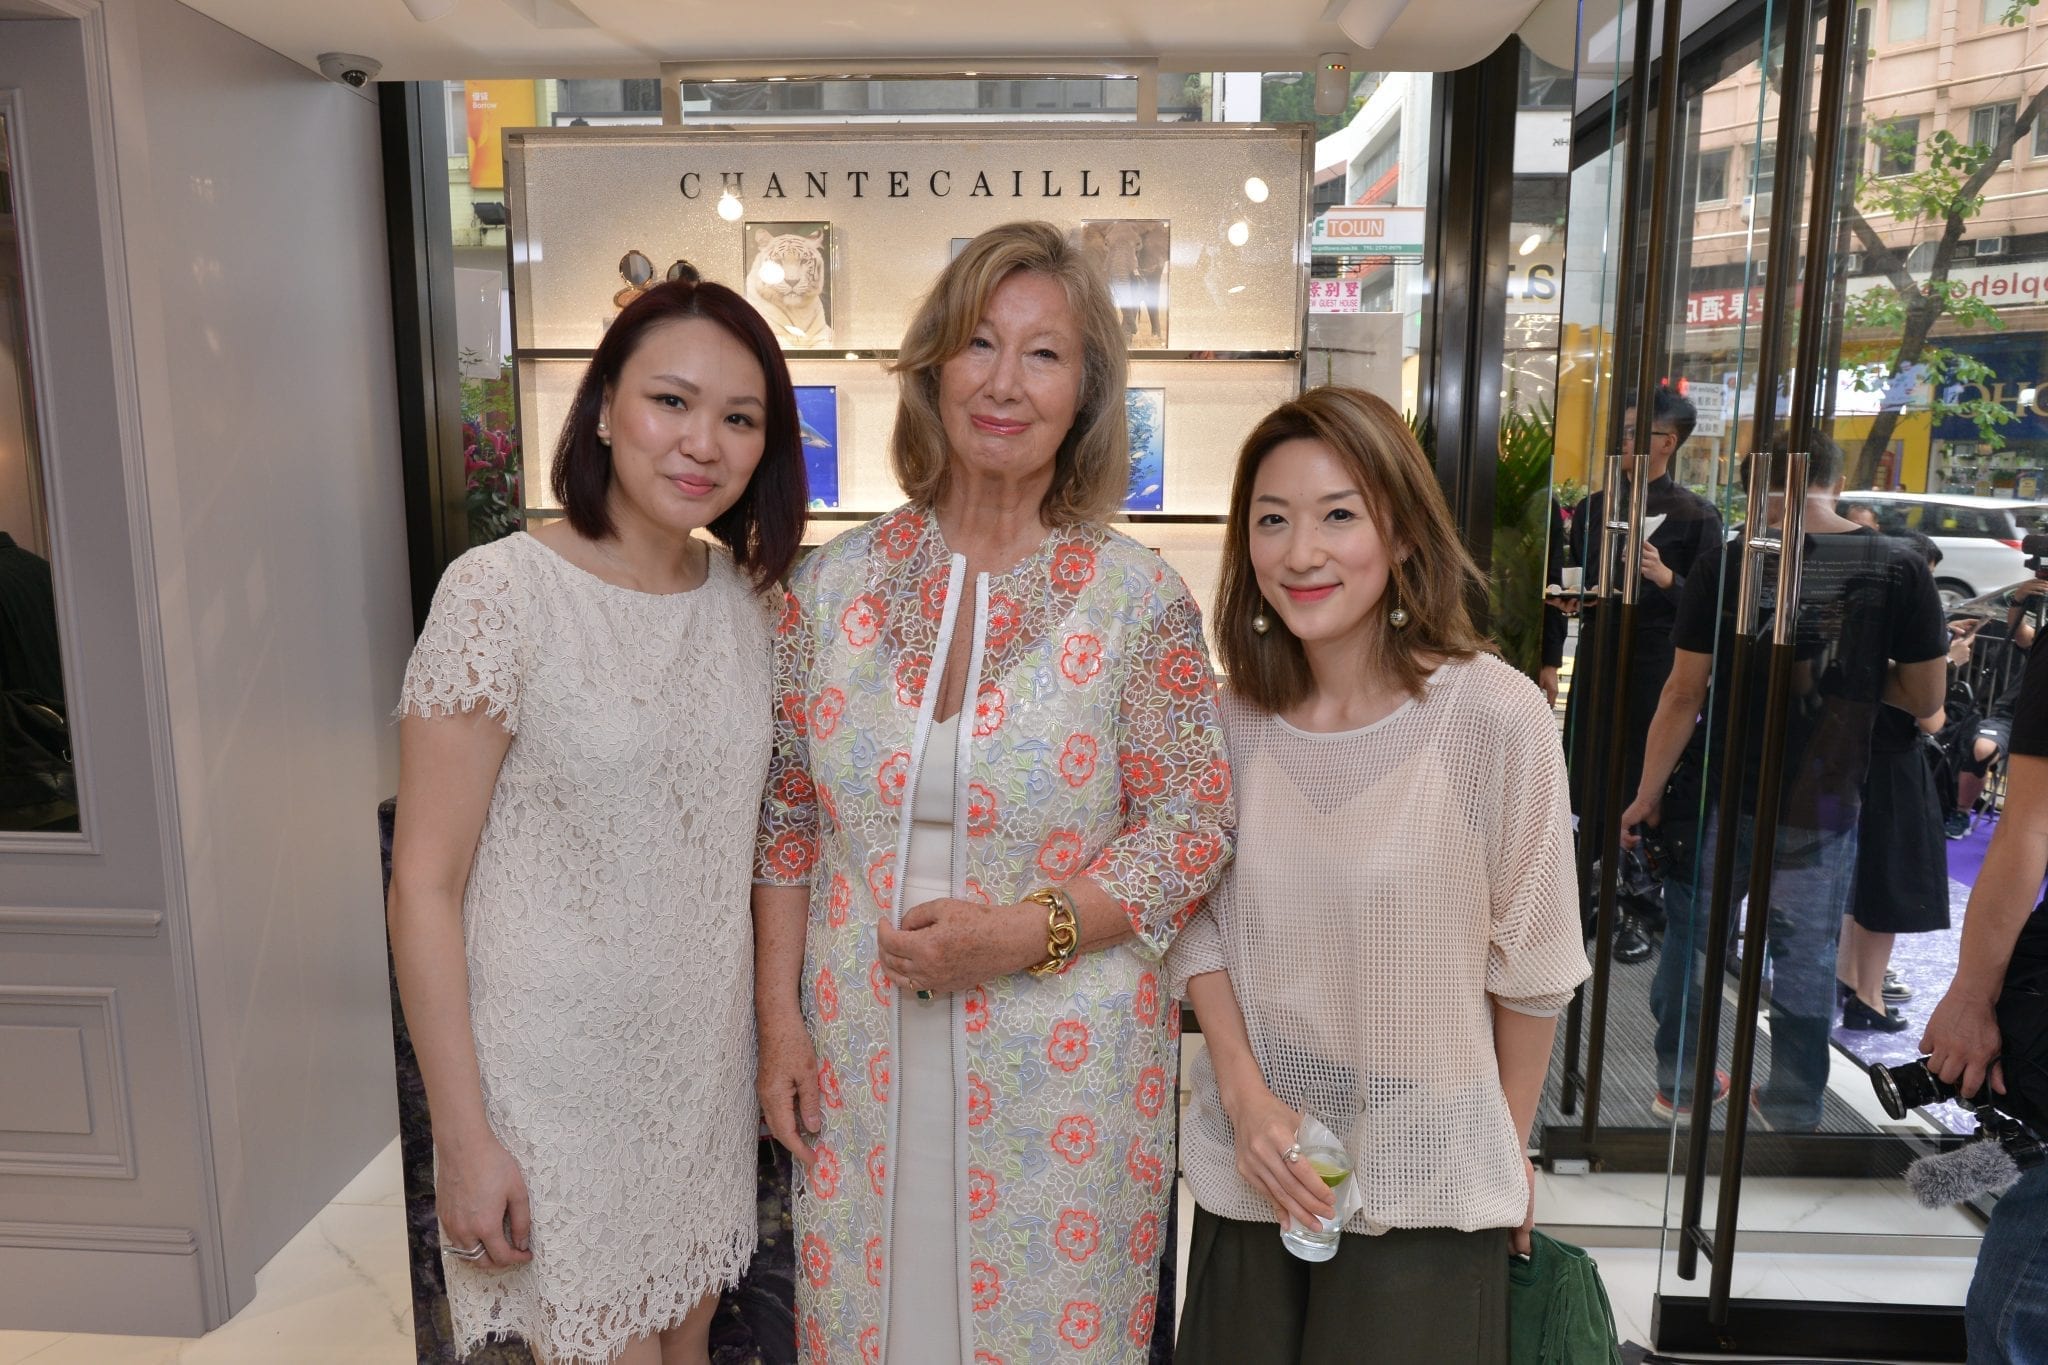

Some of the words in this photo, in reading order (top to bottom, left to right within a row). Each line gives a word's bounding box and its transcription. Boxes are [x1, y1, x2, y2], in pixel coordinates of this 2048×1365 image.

[680, 170, 1141, 199] CHANTECAILLE
[1329, 220, 1383, 236] TOWN
[1319, 299, 1337, 307] GUEST
[1340, 299, 1358, 307] HOUSE
